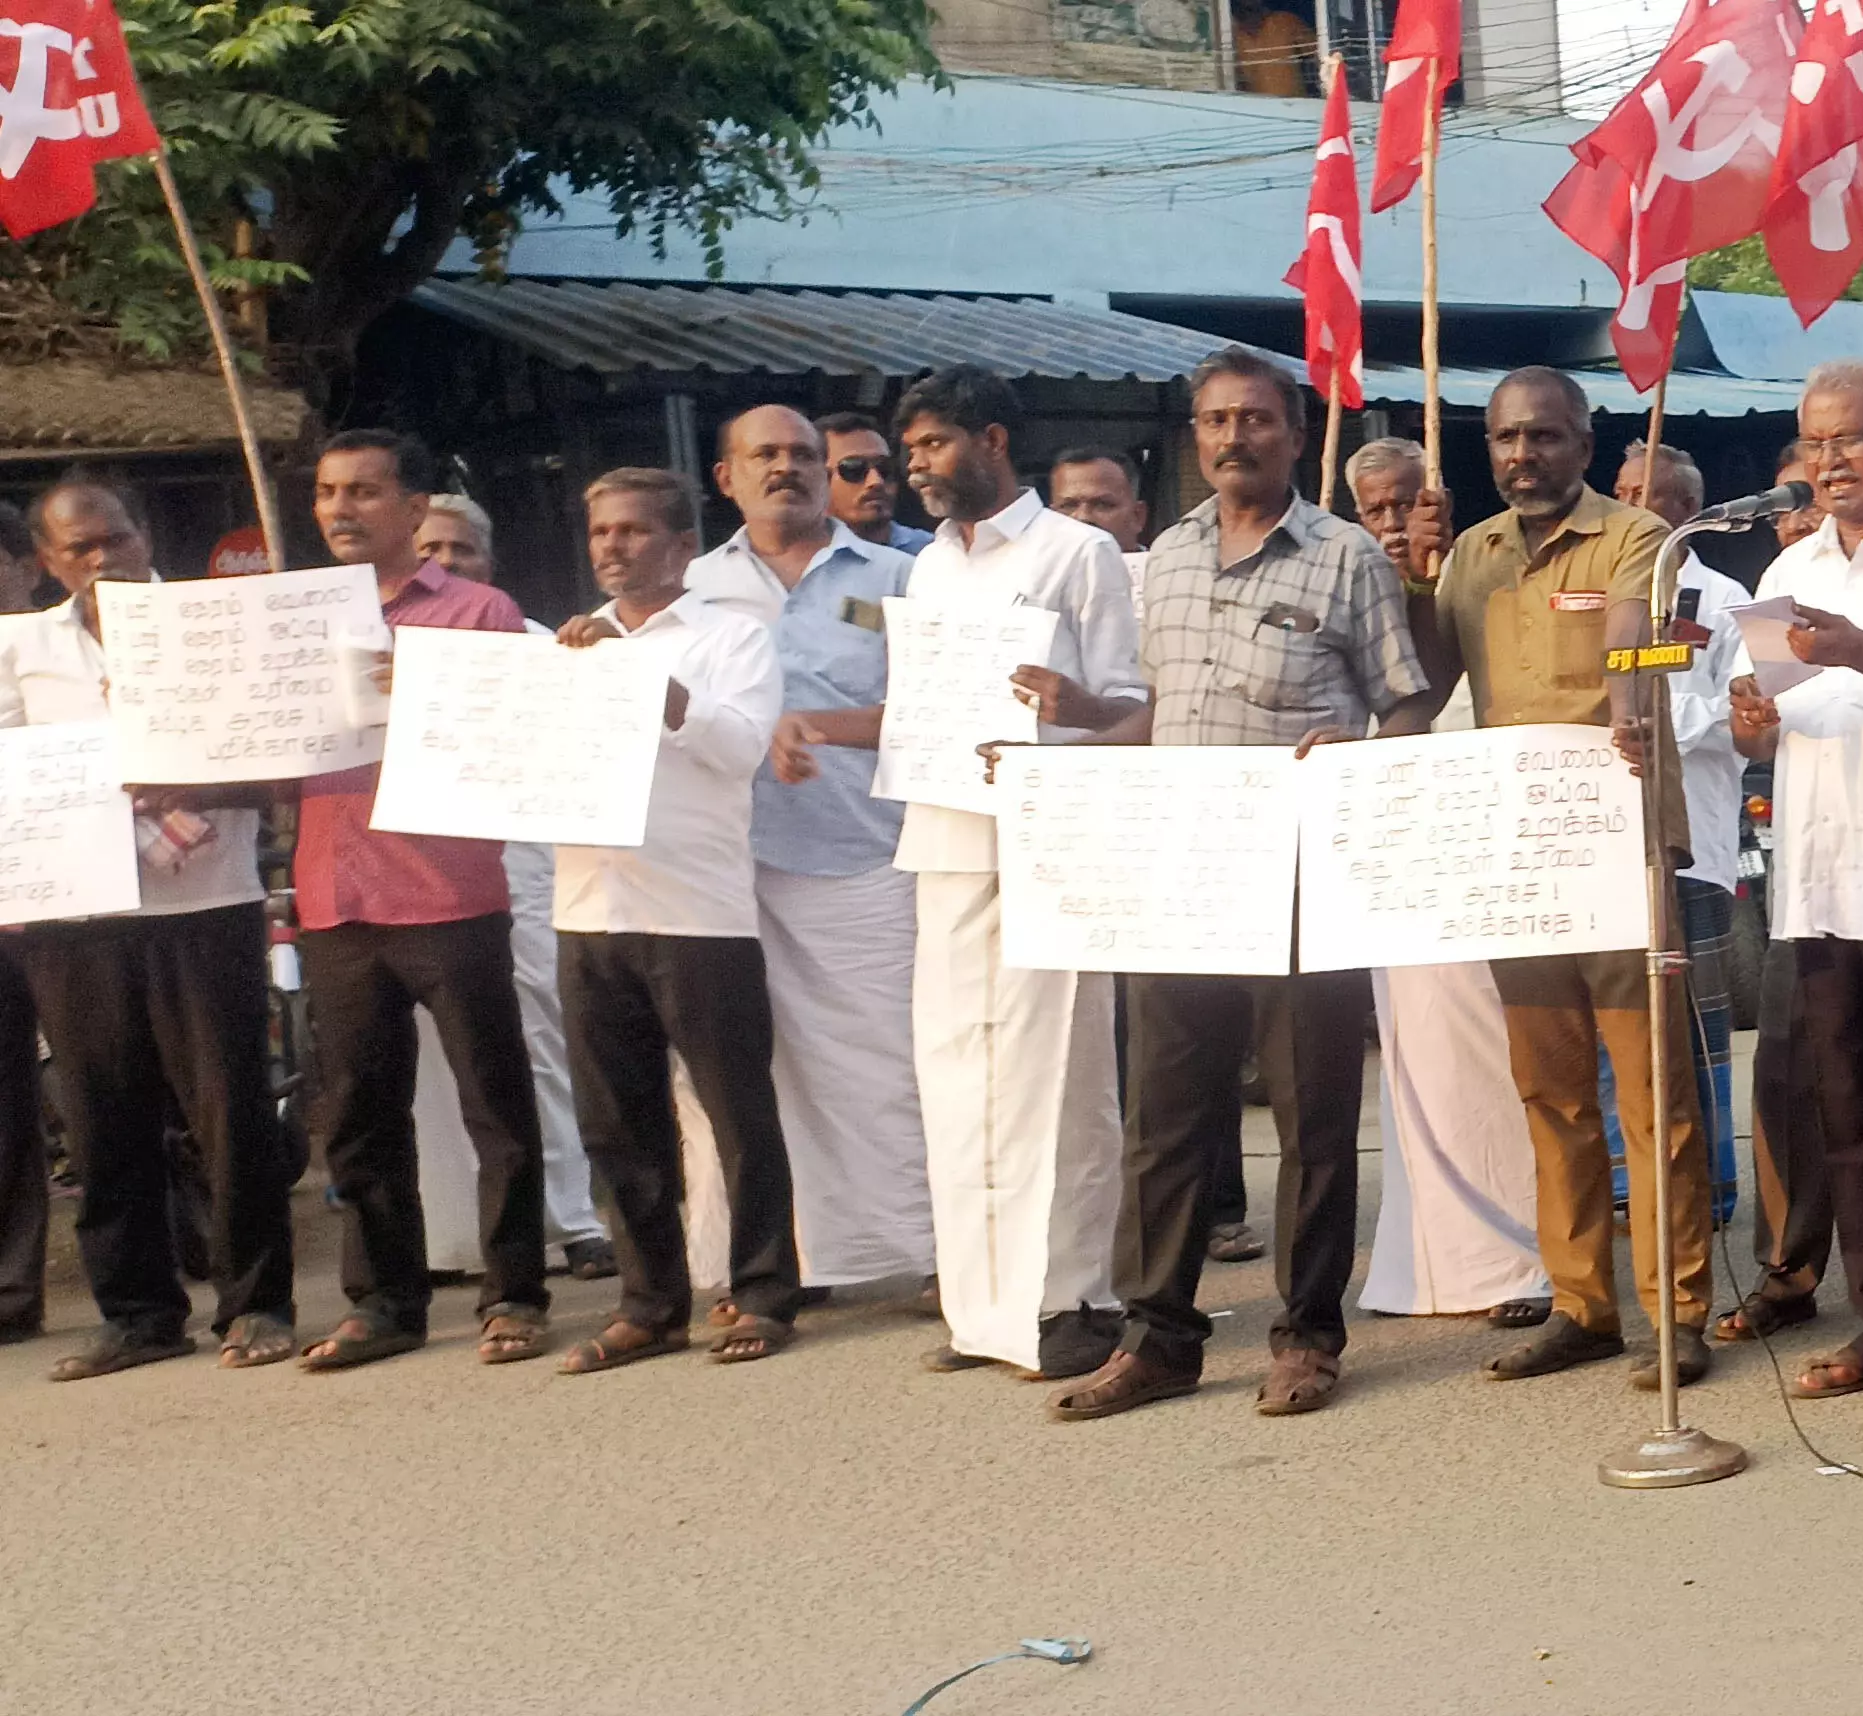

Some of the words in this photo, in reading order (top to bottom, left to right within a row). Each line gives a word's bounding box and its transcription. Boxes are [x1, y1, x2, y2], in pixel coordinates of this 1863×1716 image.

[1516, 748, 1614, 772] வேலை
[1516, 806, 1628, 849] உறக்கம்
[1462, 882, 1540, 917] அரசே
